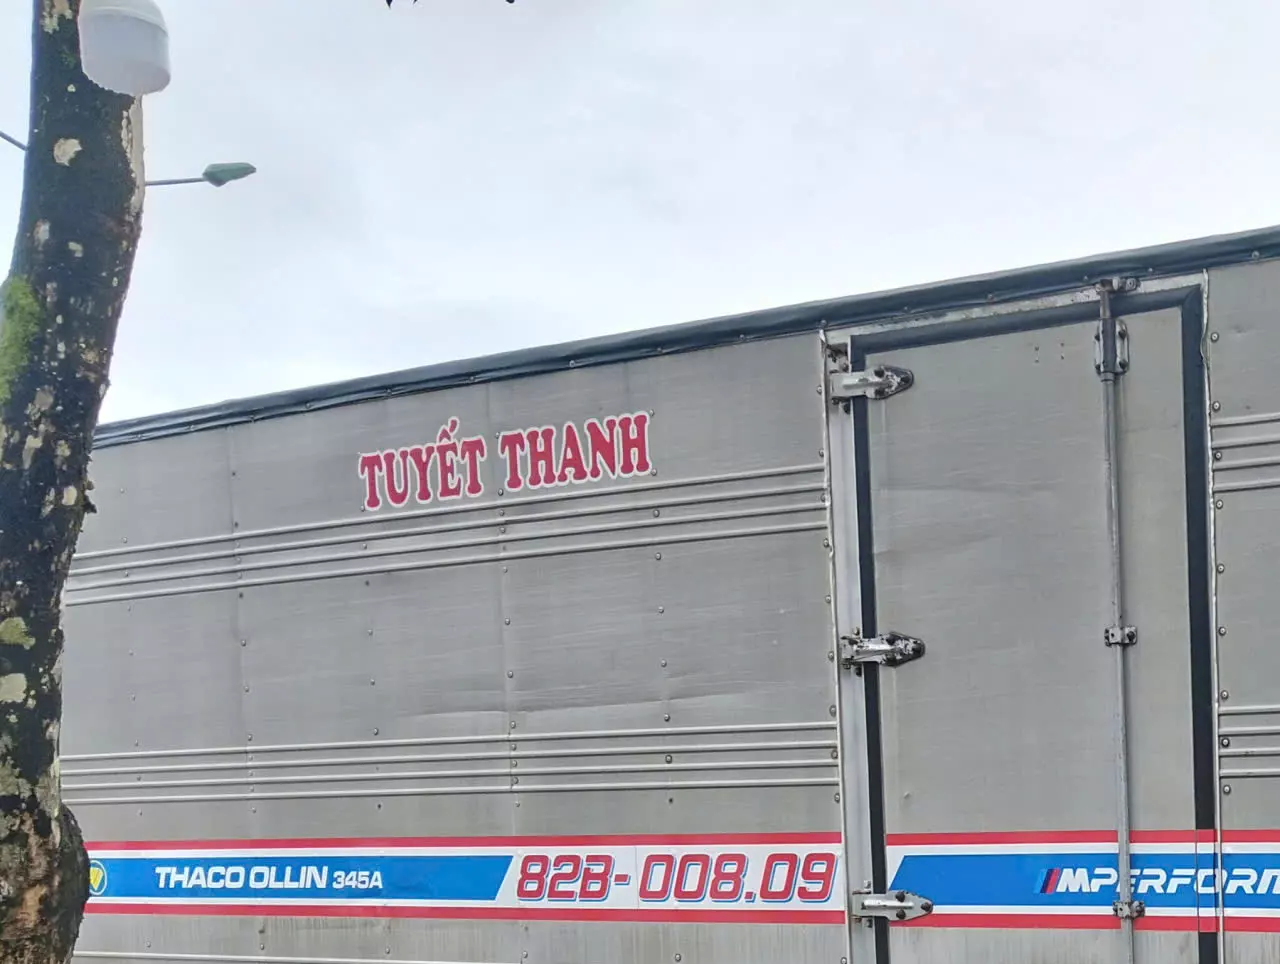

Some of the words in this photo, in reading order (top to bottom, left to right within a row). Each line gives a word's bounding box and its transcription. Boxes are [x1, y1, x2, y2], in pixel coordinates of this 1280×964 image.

[359, 416, 487, 511] TUYẾT
[498, 410, 651, 491] THANH
[155, 866, 245, 889] THACO
[249, 866, 329, 889] OLLIN
[332, 871, 383, 889] 345A
[517, 852, 842, 904] 82B-008.09
